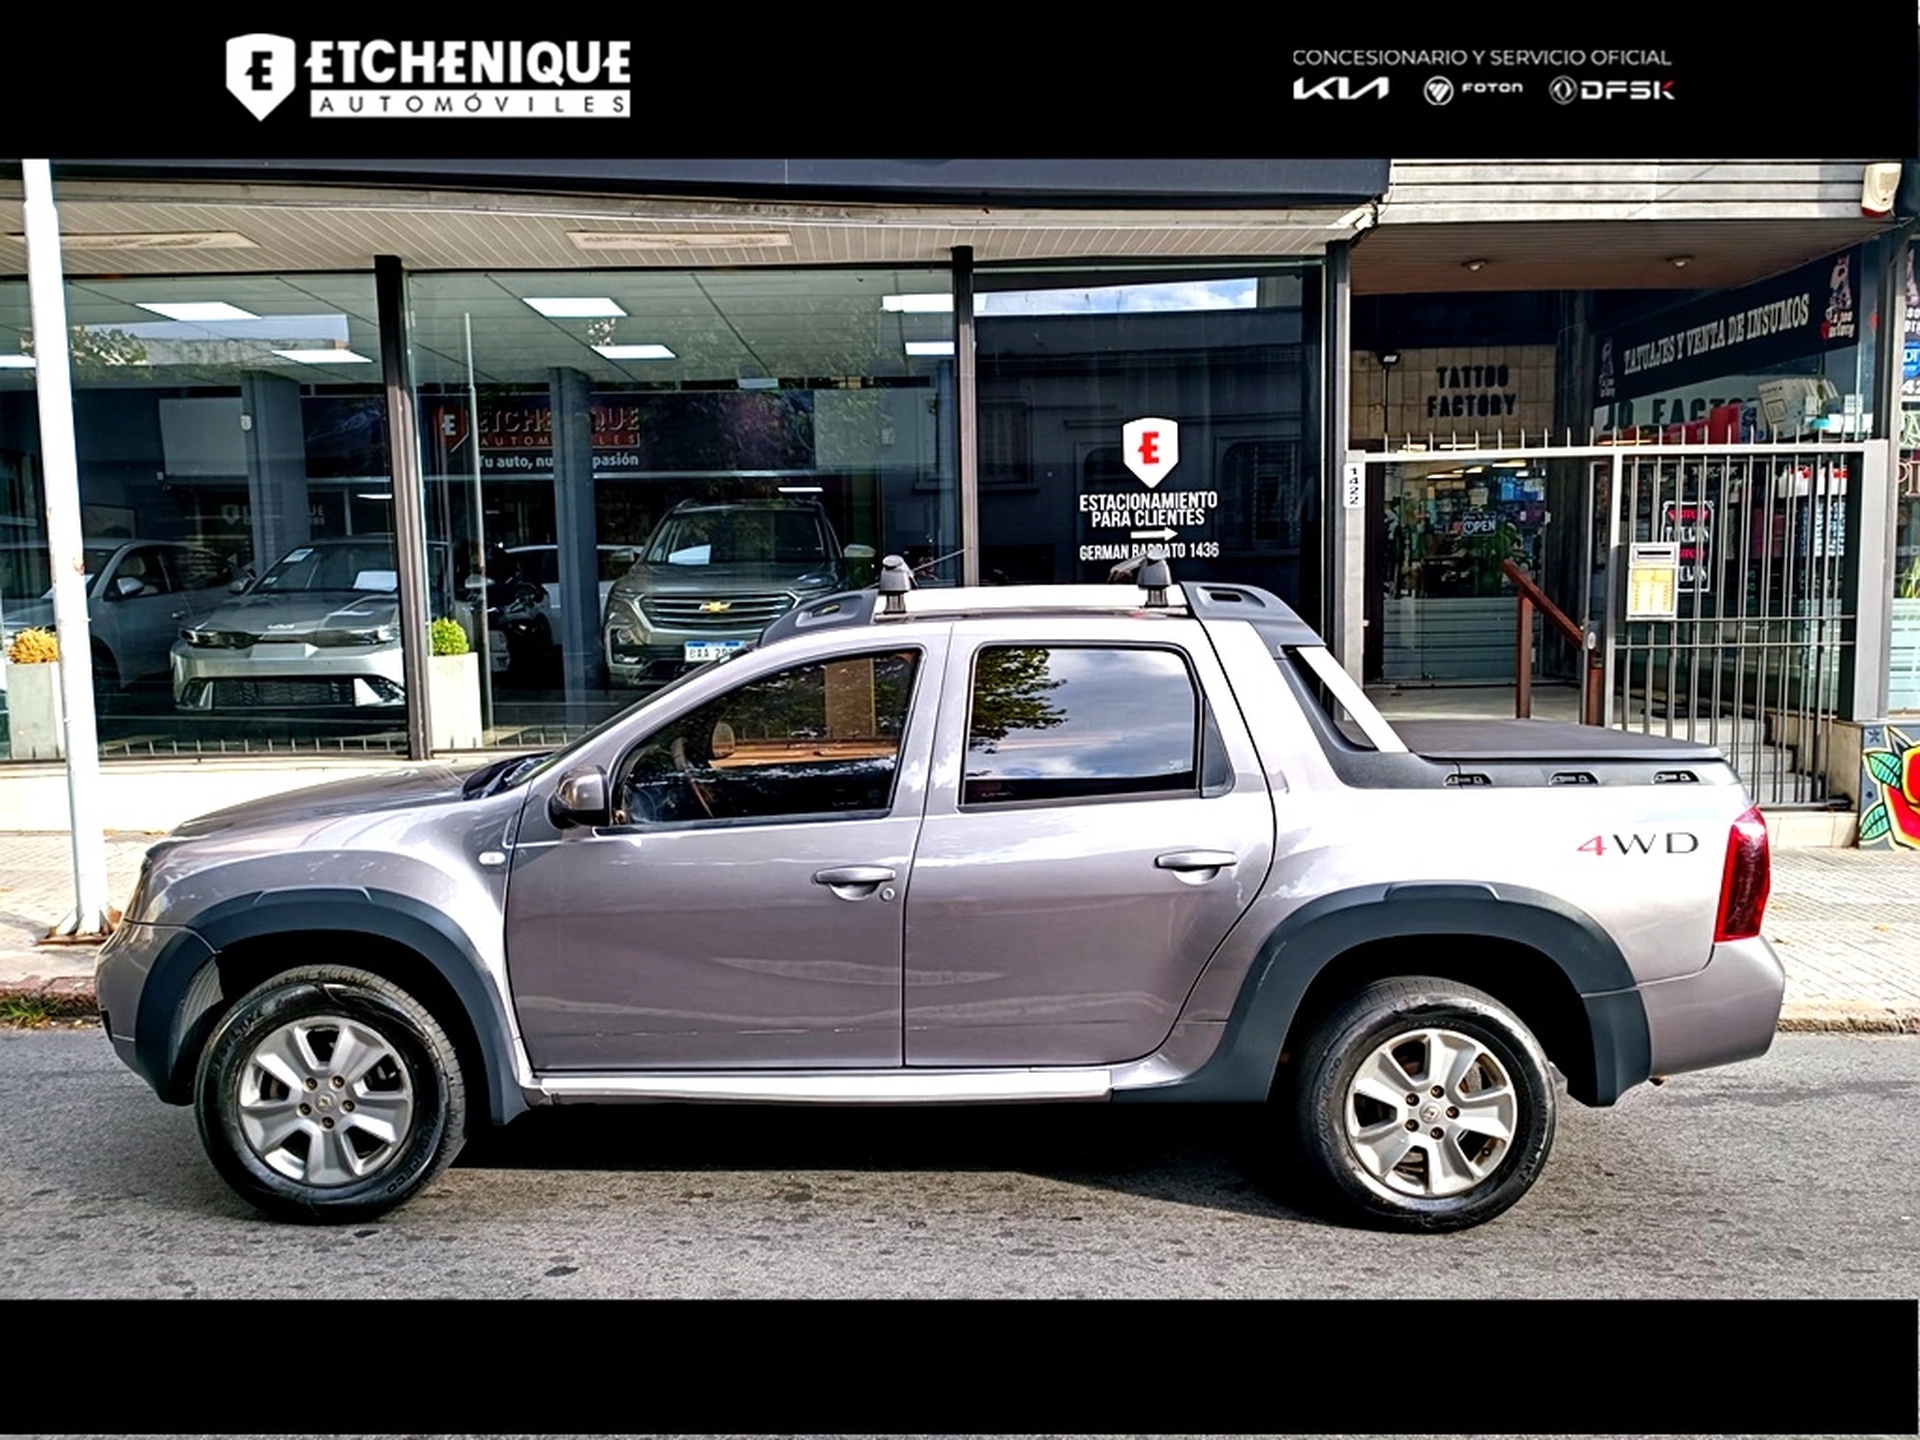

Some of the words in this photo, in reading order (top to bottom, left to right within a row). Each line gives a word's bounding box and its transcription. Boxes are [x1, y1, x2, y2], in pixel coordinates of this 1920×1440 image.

[1686, 318, 1726, 357] VENTA
[1727, 312, 1745, 346] DE
[1746, 292, 1810, 340] INSUMOS
[1436, 365, 1509, 389] TATTOO
[1427, 394, 1516, 418] FACTORY
[496, 456, 533, 470] auto,
[592, 453, 639, 470] pasión
[1349, 466, 1359, 505] 1422
[1079, 491, 1218, 512] ESTACIONAMIENTO
[1092, 511, 1131, 528] PARA
[1135, 509, 1206, 526] CLIENTES
[1079, 545, 1129, 561] GERMAN
[1190, 541, 1220, 558] 1436
[1577, 832, 1699, 856] 4WD
